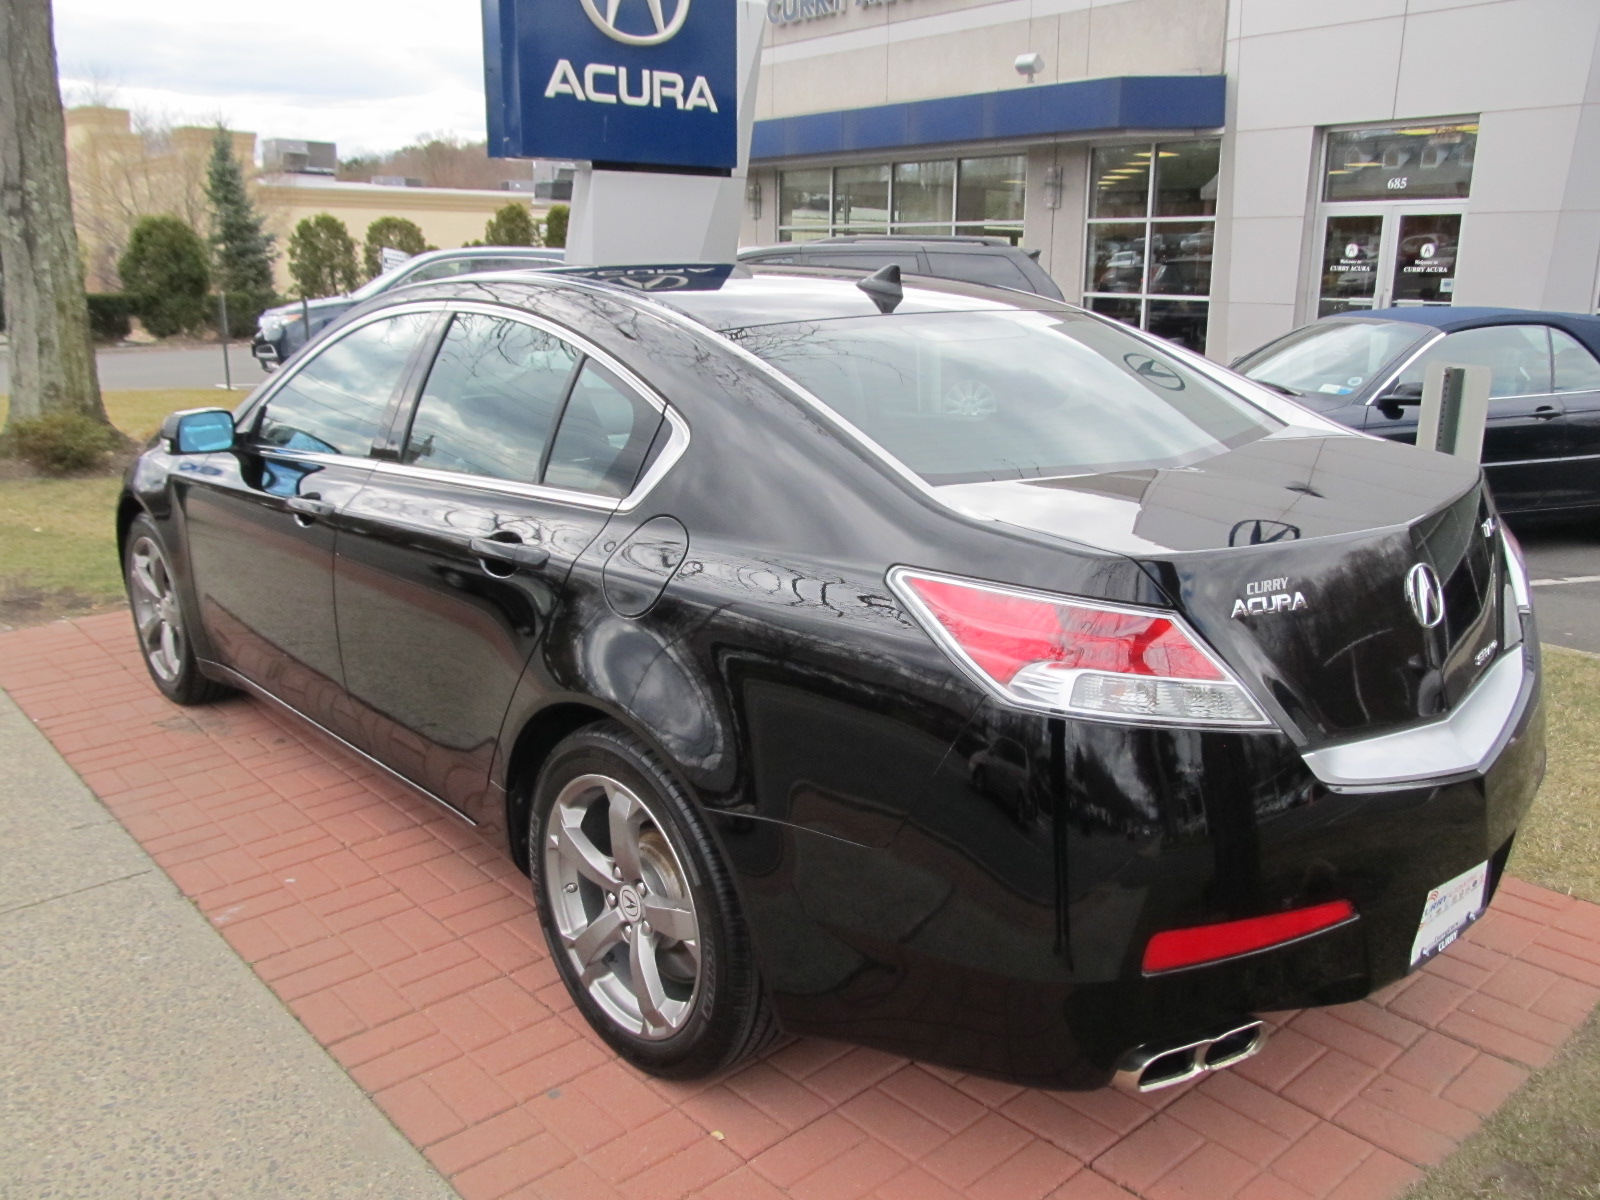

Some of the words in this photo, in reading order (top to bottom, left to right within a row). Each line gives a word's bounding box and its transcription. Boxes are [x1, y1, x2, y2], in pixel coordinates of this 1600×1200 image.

[544, 59, 719, 113] ACURA
[1387, 177, 1408, 189] 685
[1246, 576, 1288, 595] CURRY
[1230, 591, 1308, 618] ACURA
[1438, 929, 1458, 952] CURRY
